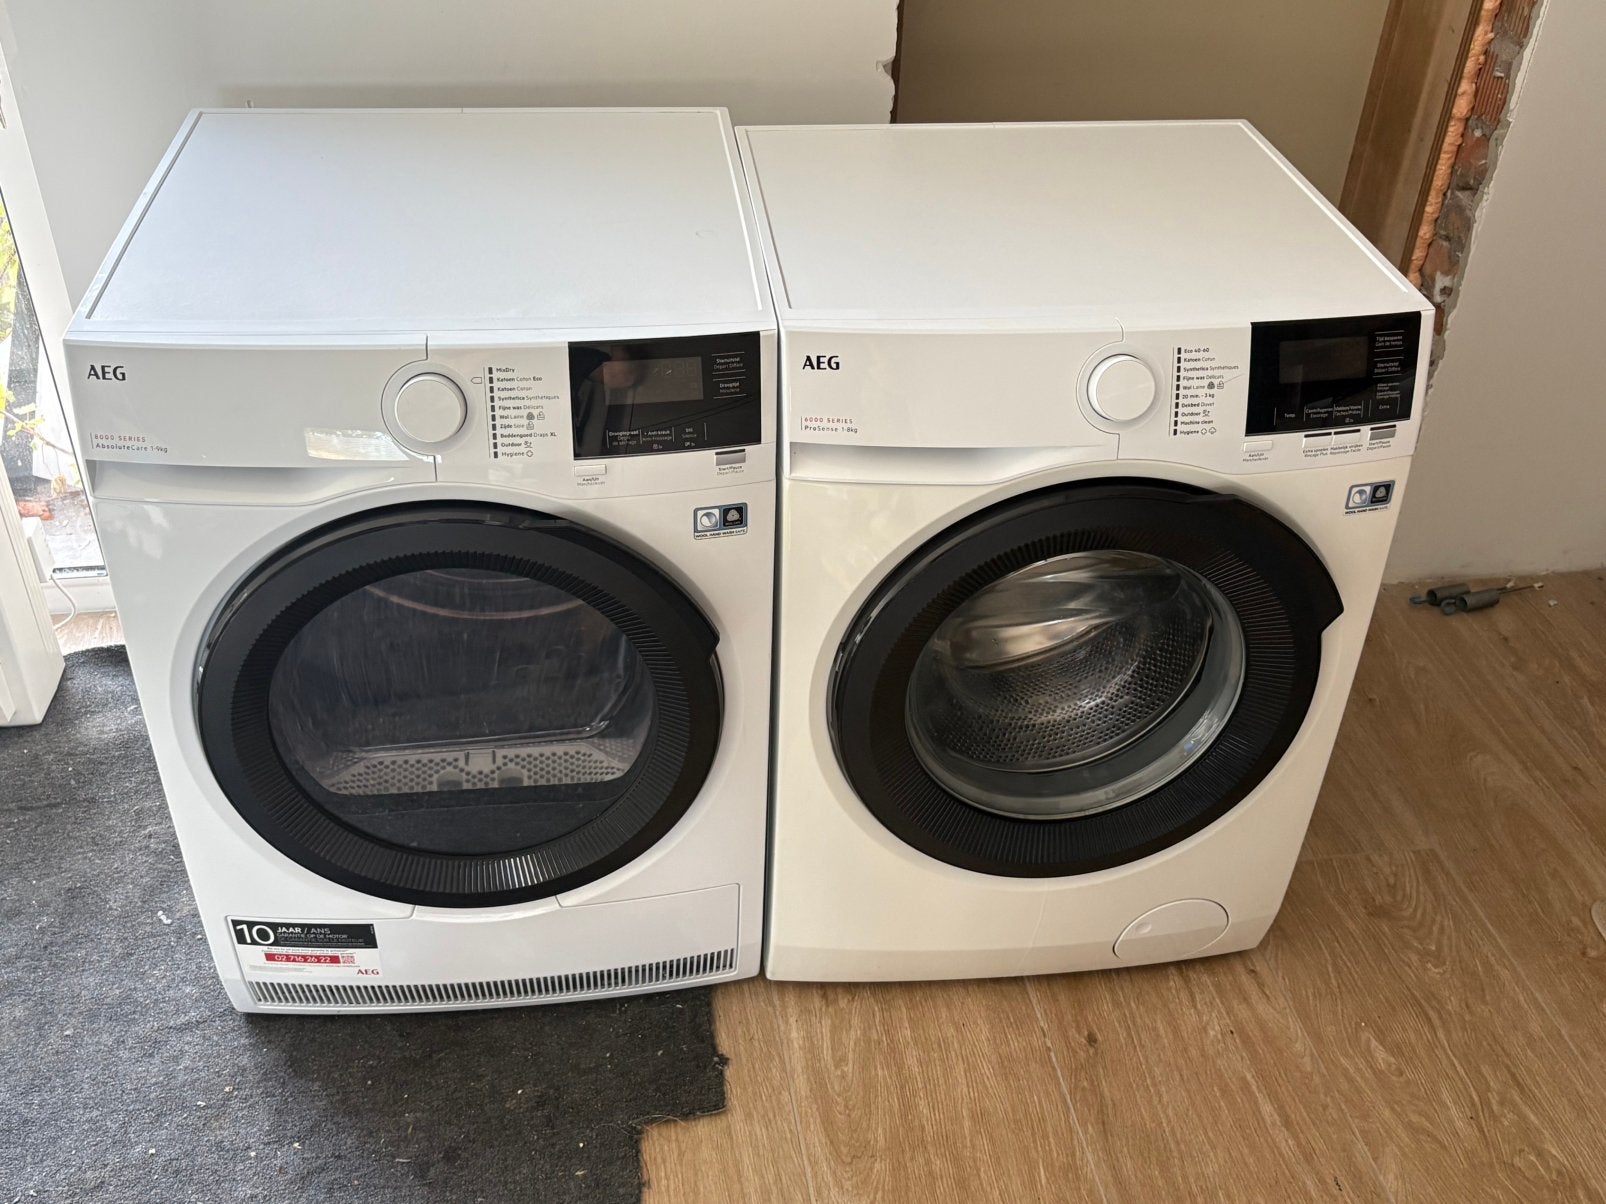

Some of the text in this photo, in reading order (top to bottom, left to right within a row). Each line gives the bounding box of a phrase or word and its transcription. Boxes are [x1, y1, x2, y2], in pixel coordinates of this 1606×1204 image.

[802, 355, 840, 370] AEG
[87, 364, 126, 381] AEG
[804, 424, 838, 432] ProSense
[118, 435, 146, 443] SERIES
[95, 442, 148, 452] AbsoluteCare
[236, 924, 275, 944] 10
